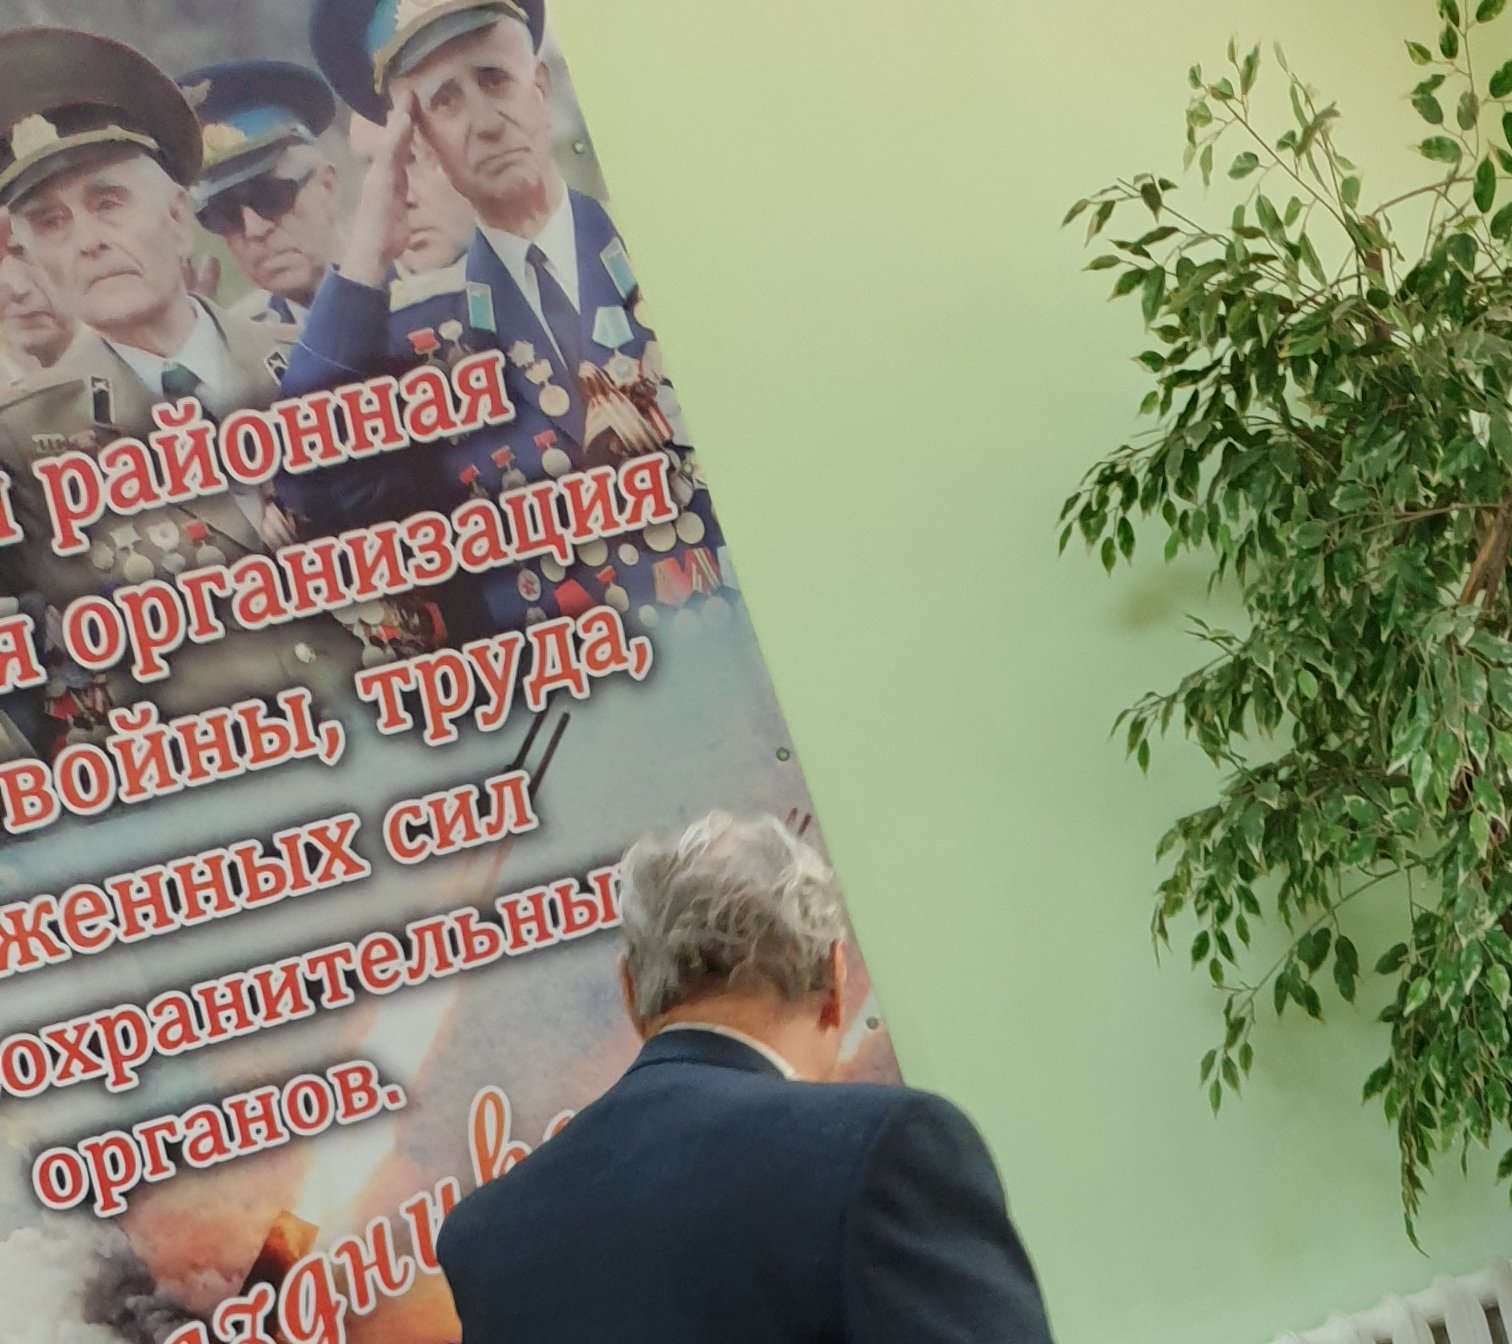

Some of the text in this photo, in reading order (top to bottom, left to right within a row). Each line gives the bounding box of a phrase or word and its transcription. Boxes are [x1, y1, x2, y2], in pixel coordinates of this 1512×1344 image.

[36, 351, 512, 553] районная
[66, 456, 676, 680] организация
[0, 607, 652, 832] войны, труда,
[386, 773, 537, 863] сил
[1, 866, 622, 1095] охранительны
[34, 1060, 405, 1214] органов.
